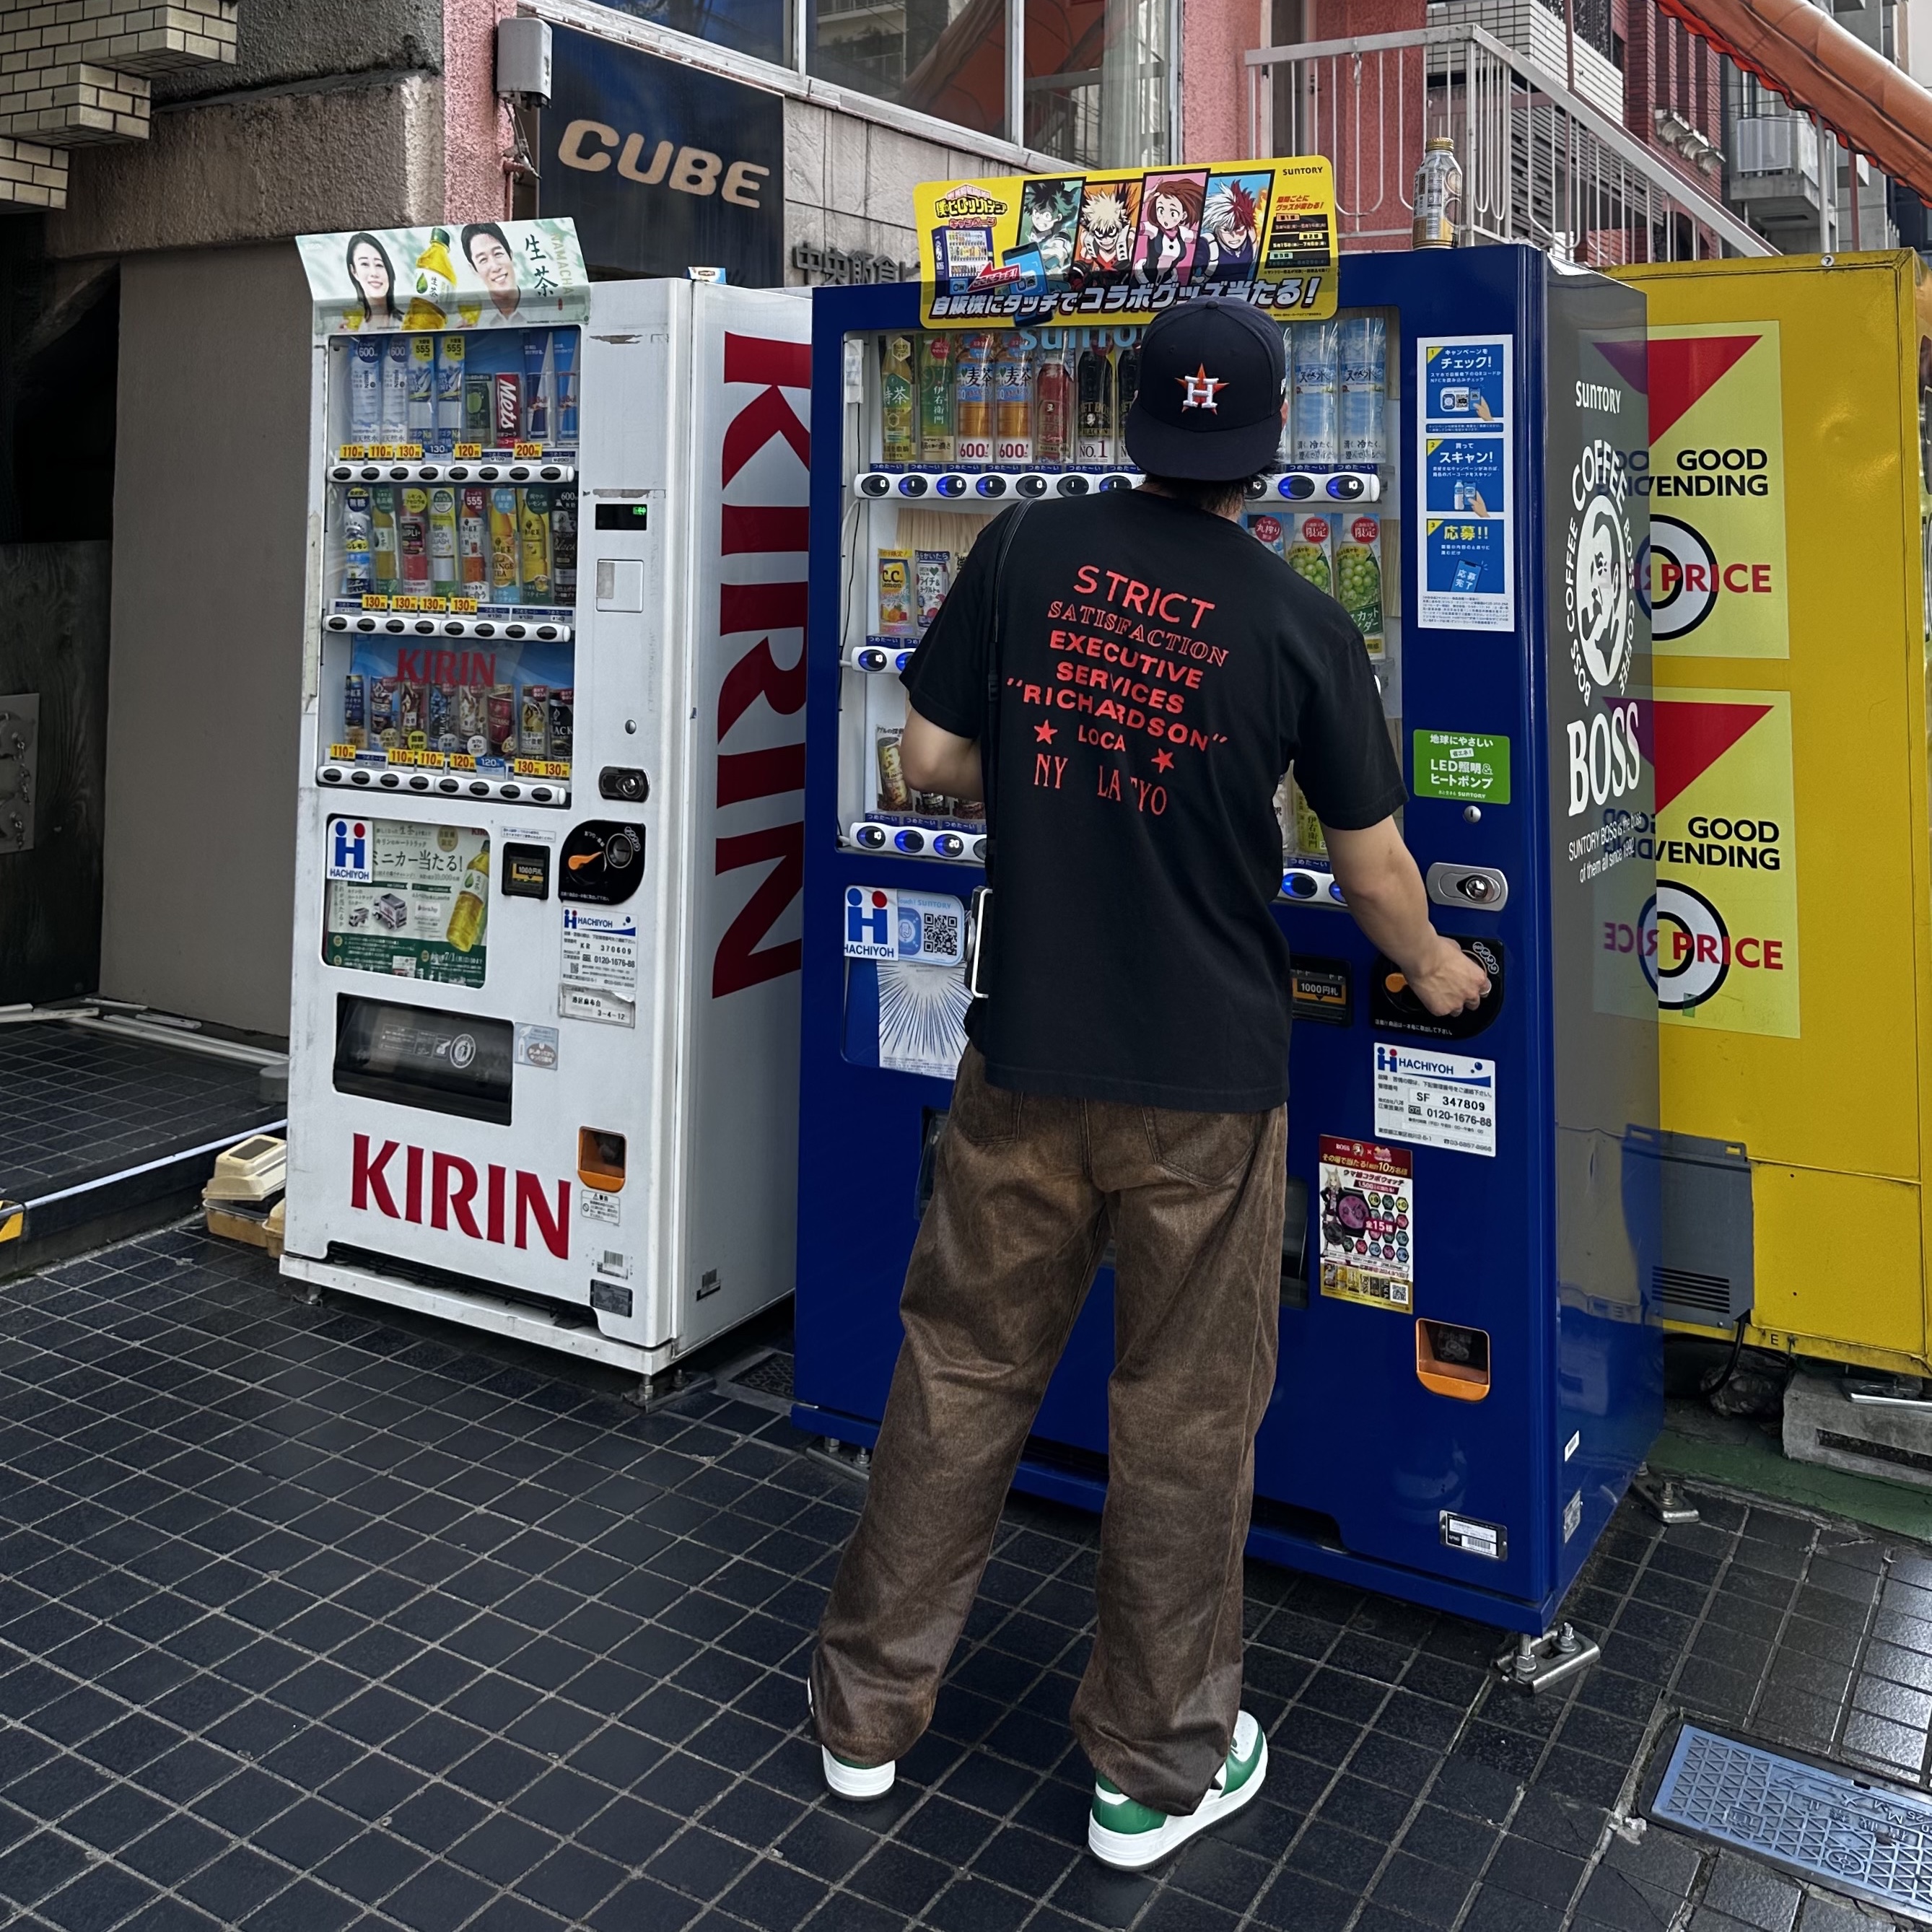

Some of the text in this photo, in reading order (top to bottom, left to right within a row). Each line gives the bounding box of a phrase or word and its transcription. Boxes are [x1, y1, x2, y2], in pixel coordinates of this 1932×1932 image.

[558, 119, 770, 209] CUBE
[1282, 167, 1323, 175] SUNTORY
[525, 233, 559, 297] 生茶
[551, 232, 575, 295] NAMACHA
[1441, 357, 1492, 370] チェック!
[968, 367, 992, 387] 麦茶
[1006, 367, 1031, 387] 麦茶
[1183, 375, 1219, 408] H
[1575, 380, 1622, 414] SUNTORY
[499, 379, 517, 429] Mets
[933, 385, 945, 424] 伊右衛門
[342, 446, 364, 458] 110円
[371, 446, 393, 458] 110円
[399, 445, 421, 458] 130円
[458, 445, 480, 457] 120円
[516, 444, 540, 457] 200円
[959, 443, 985, 458] 600
[999, 444, 1024, 458] 600
[1440, 452, 1492, 463] スキャン!
[1676, 448, 1768, 471] GOOD
[1571, 439, 1627, 515] COFFEE
[1306, 527, 1326, 537] 限定
[1355, 527, 1376, 538] 限定
[1444, 525, 1488, 541] 応募!!
[1455, 579, 1473, 590] 完了
[1661, 563, 1773, 593] PRICE
[365, 596, 385, 608] 130円
[395, 598, 416, 609] 130円
[423, 599, 443, 610] 130円
[1073, 564, 1215, 629] STRICT
[454, 600, 475, 611] 130円
[1047, 600, 1230, 667] SATISFACTION
[398, 647, 496, 686] KIRIN
[712, 331, 811, 998] KIRIN
[1049, 629, 1204, 690] EXECUTIVE
[1056, 661, 1185, 714] SERVICES
[1430, 734, 1494, 747] 地球にやさしい
[333, 745, 354, 758] 110円
[391, 750, 414, 763] 110円
[420, 753, 442, 766] 110円
[1567, 701, 1640, 817] BOSS
[453, 755, 475, 768] 120円
[517, 761, 540, 774] 130円
[545, 763, 567, 776] 130円
[1430, 759, 1493, 775] LED照明&
[1033, 753, 1068, 790] NY
[1430, 773, 1493, 789] ヒートポンプ
[1687, 816, 1780, 844] GOOD
[1569, 829, 1600, 861] SUNTORY
[1601, 821, 1617, 845] BOSS
[1580, 862, 1586, 883] of
[1587, 860, 1601, 879] them
[1609, 848, 1622, 867] since
[330, 868, 370, 880] HACHIYOH
[917, 899, 952, 909] SUNTORY
[578, 917, 613, 928] HACHIYOH
[844, 945, 894, 958] HACHIYOH
[1672, 931, 1784, 971] PRICE
[1300, 982, 1339, 997] 1000円札
[1399, 1058, 1454, 1075] HACHIYOH
[1417, 1092, 1485, 1111] SF 347809
[1427, 1108, 1492, 1127] 0120-1676-88
[351, 1132, 572, 1261] KIRIN
